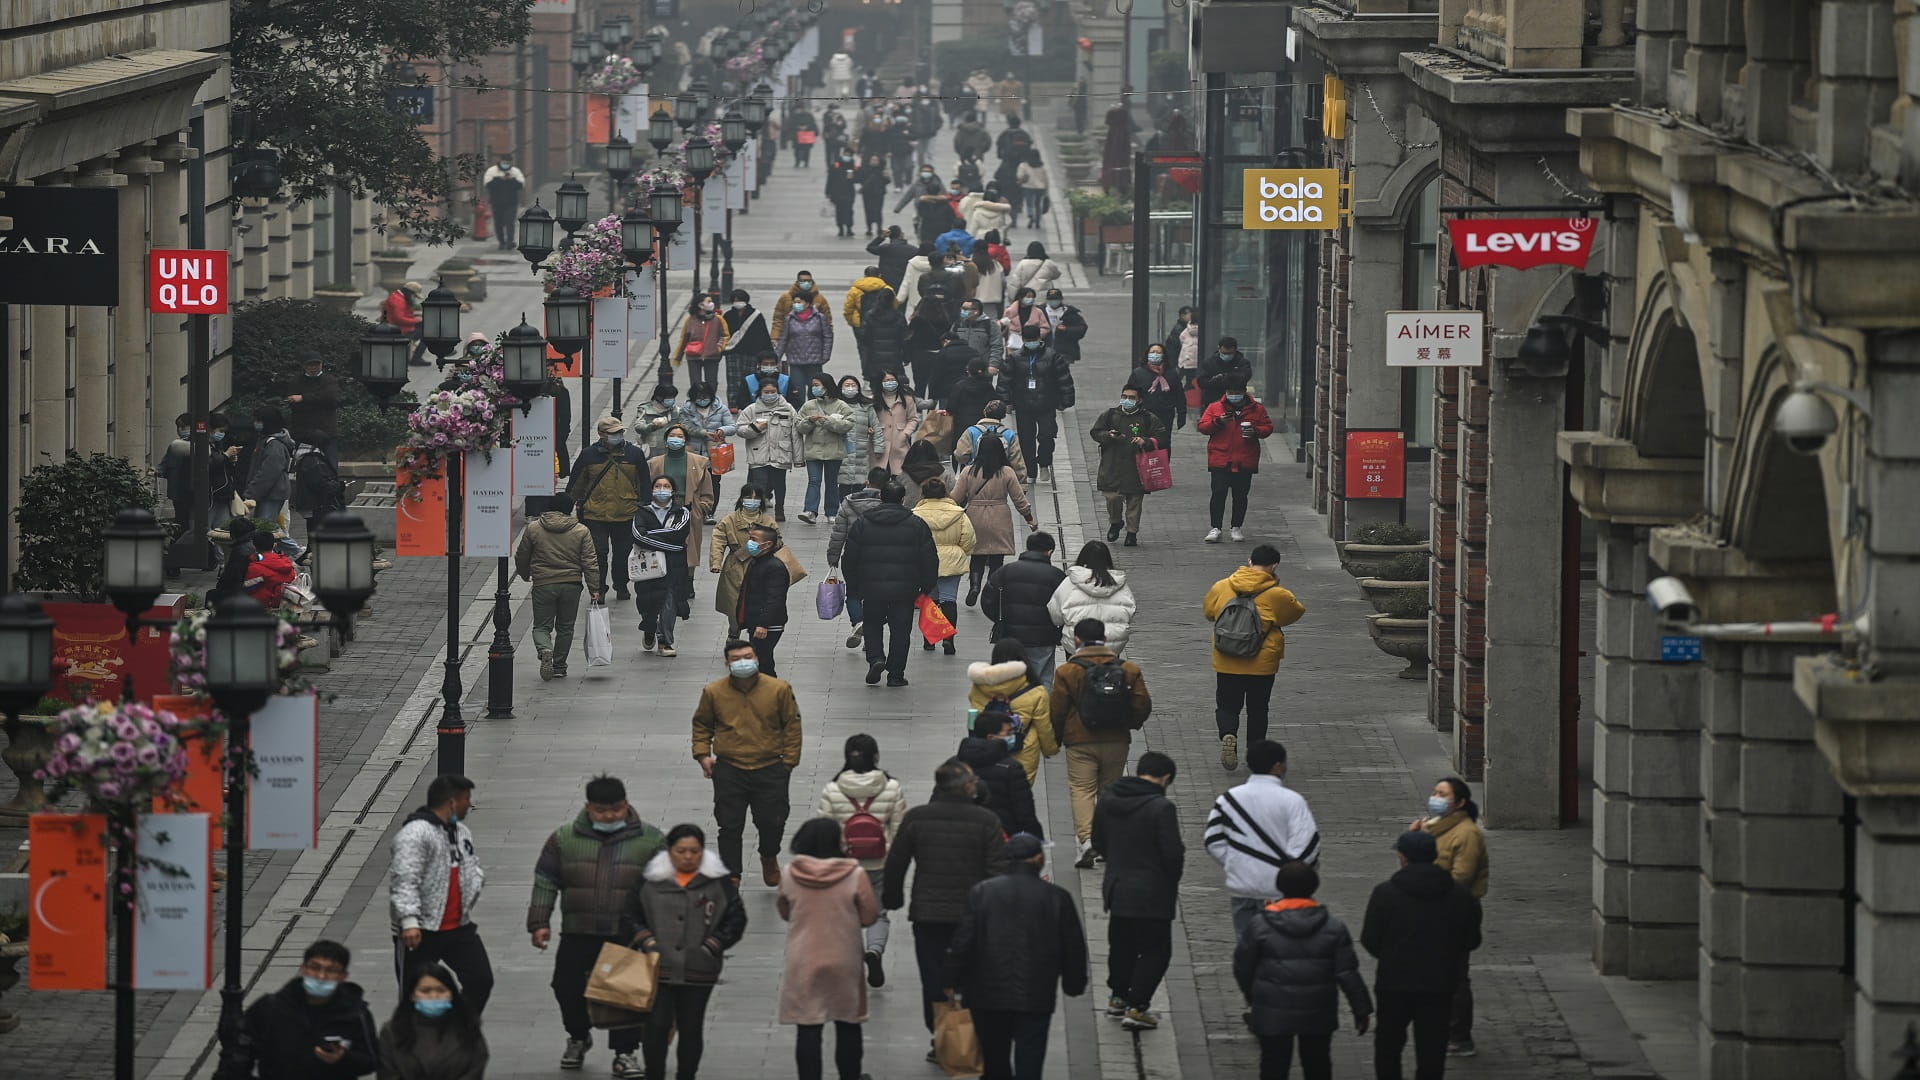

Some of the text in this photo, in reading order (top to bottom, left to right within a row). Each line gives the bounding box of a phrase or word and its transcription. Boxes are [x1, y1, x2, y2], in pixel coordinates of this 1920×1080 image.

[1260, 176, 1323, 199] bala
[1259, 199, 1323, 222] bala
[159, 257, 213, 280] UNI
[159, 283, 218, 309] QLO
[1398, 318, 1471, 339] AÍMER
[1416, 347, 1452, 360] 爱慕
